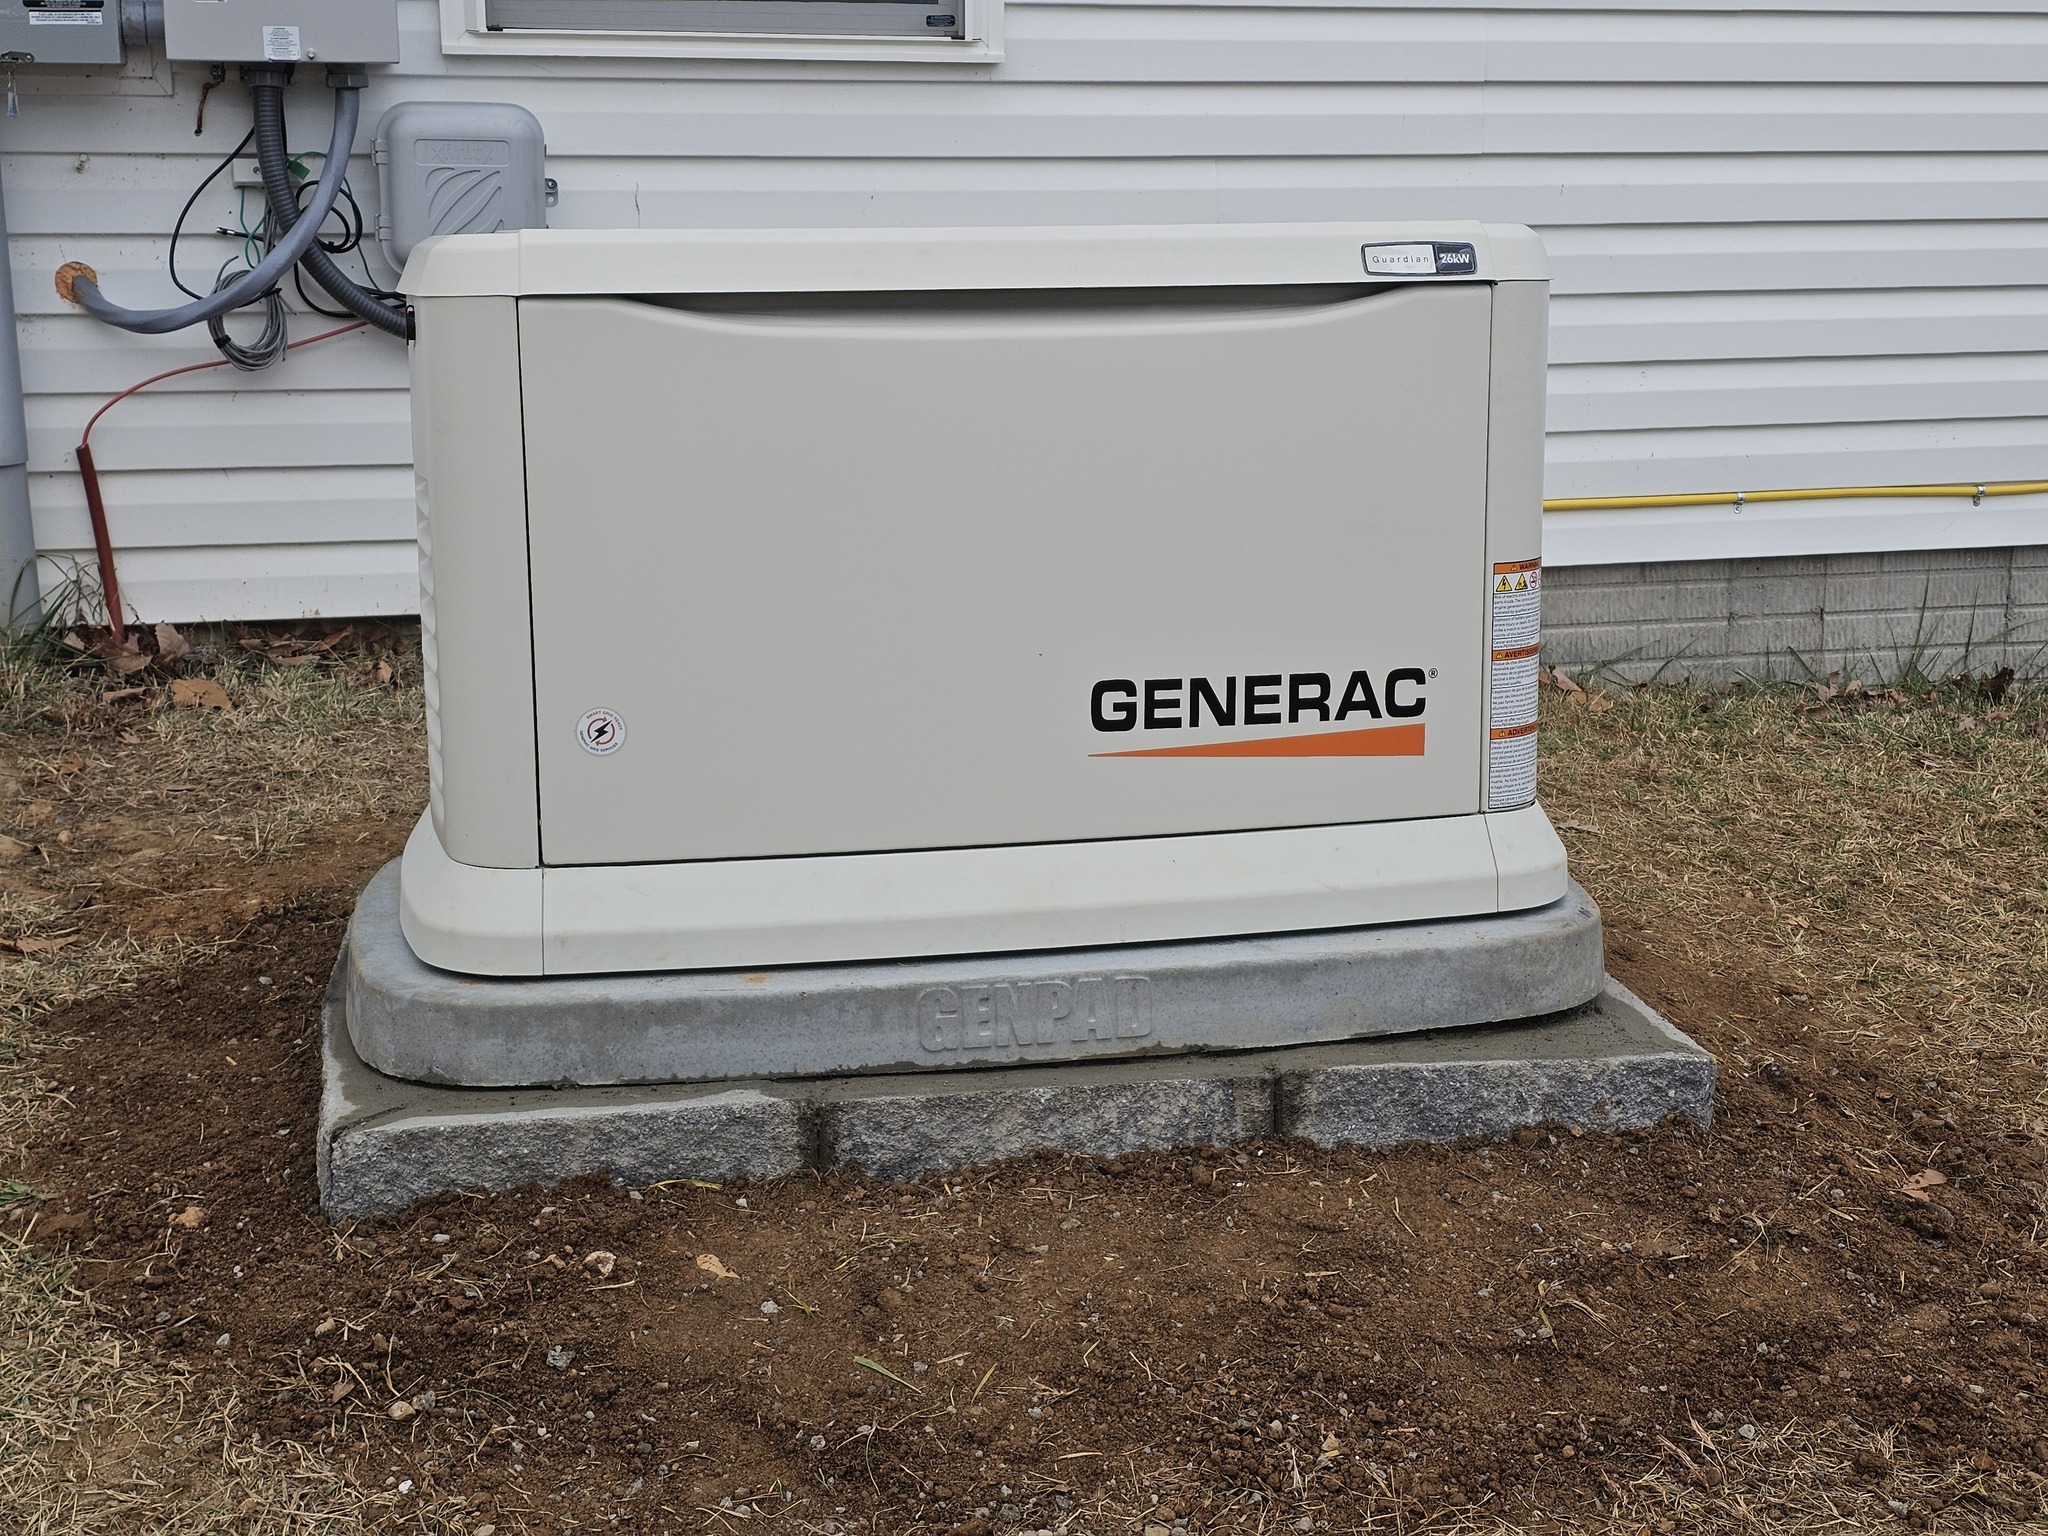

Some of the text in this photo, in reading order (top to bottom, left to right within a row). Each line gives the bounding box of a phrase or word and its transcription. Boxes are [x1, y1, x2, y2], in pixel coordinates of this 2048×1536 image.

[1372, 253, 1470, 264] Guardian 26kW
[586, 710, 601, 720] SMART
[919, 976, 1152, 1052] GENPAD
